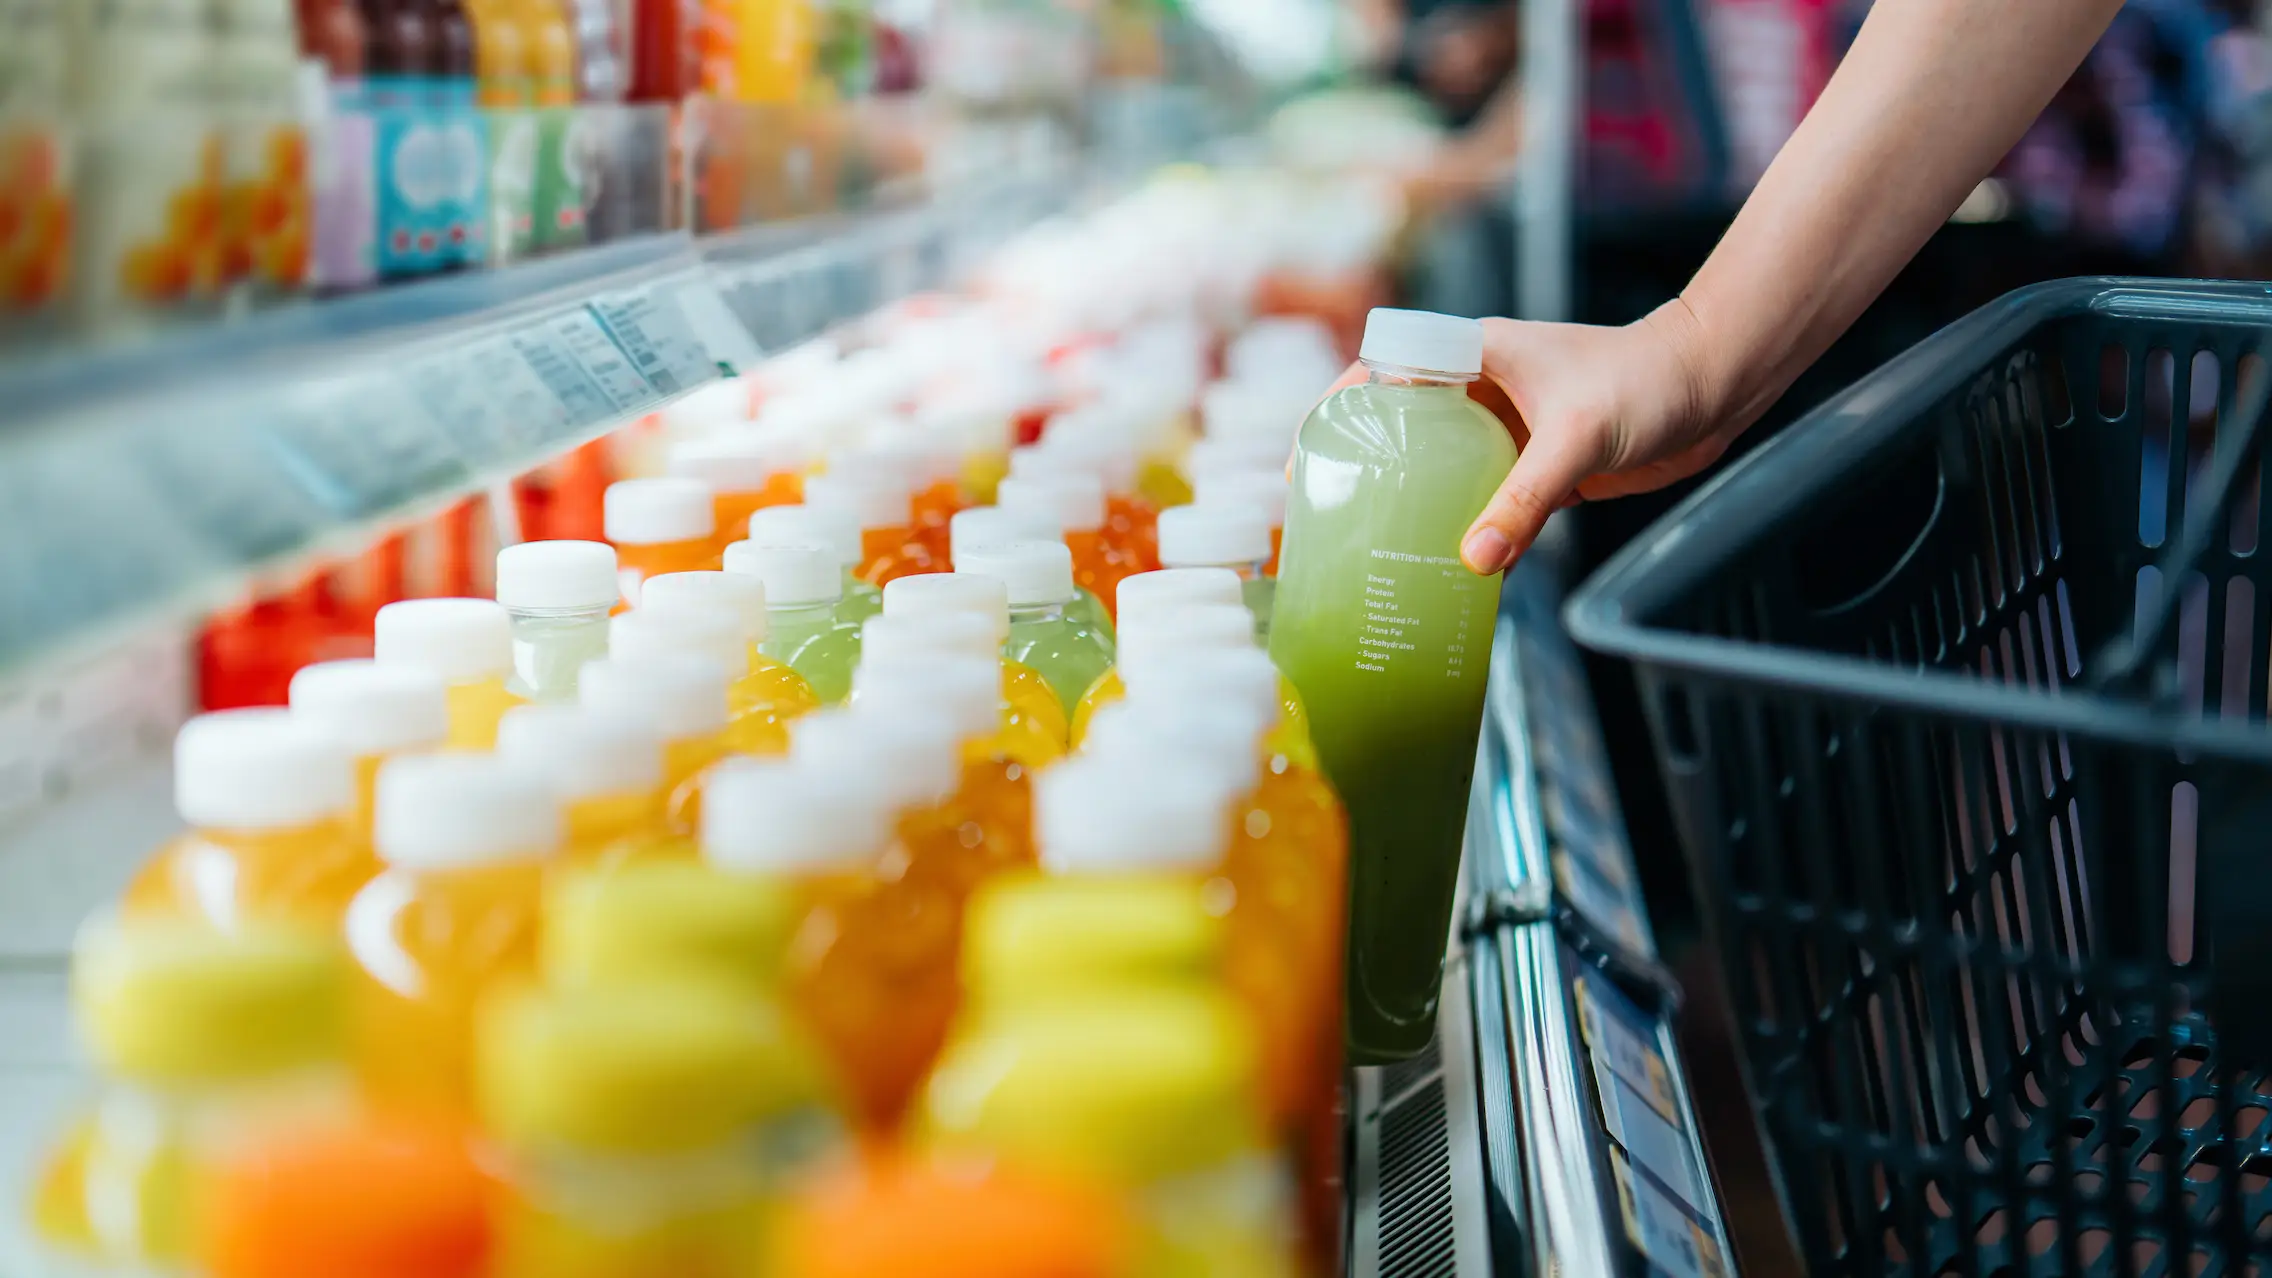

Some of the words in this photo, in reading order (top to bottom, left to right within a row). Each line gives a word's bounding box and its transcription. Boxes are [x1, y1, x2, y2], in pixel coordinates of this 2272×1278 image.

[1371, 549, 1420, 563] NUTRITION
[1423, 556, 1461, 566] INFORM
[1368, 574, 1395, 586] Energy
[1366, 587, 1394, 597] Protein
[1365, 599, 1384, 609] Total
[1385, 602, 1398, 611] Fat
[1368, 613, 1406, 625] Saturated
[1407, 618, 1420, 626] Fat
[1367, 625, 1388, 635] Trans
[1390, 628, 1402, 636] Fat
[1359, 637, 1415, 651] Carbohydrates
[1363, 650, 1390, 660] Sugars
[1355, 661, 1385, 672] Sodium
